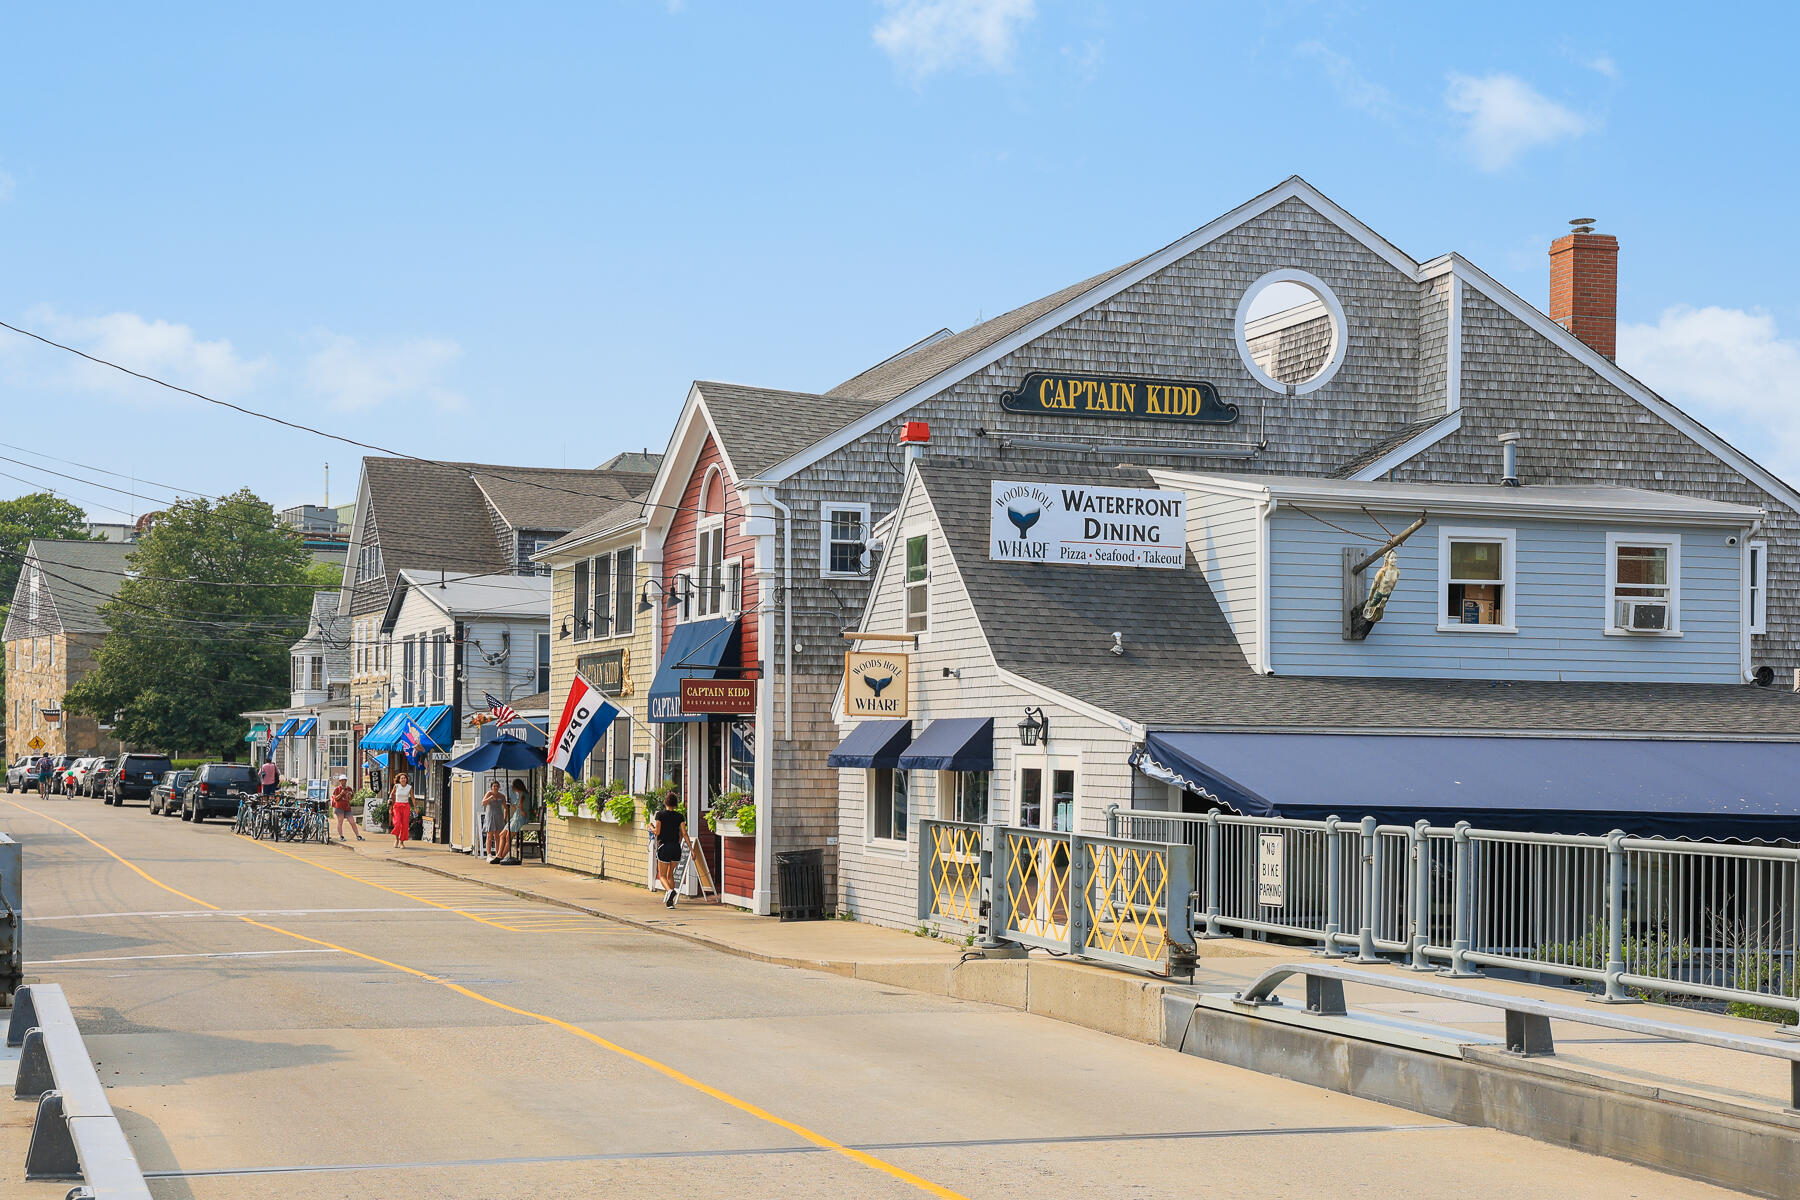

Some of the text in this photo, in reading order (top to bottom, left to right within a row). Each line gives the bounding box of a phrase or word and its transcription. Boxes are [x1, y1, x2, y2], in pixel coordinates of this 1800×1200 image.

[1039, 378, 1202, 416] CAPTAIN KIDD
[995, 486, 1055, 512] WOODS HOLE
[1061, 489, 1182, 517] WATERFRONT
[1084, 517, 1160, 543] DINING
[998, 540, 1050, 559] WHARF
[1060, 546, 1182, 565] Pizza Seafood Takeout
[604, 661, 619, 685] KIDD
[852, 659, 903, 677] WOODS HOLE
[686, 686, 750, 697] CAPTAIN KIDD
[855, 697, 900, 711] WHARF
[371, 771, 380, 792] OPEN
[1266, 842, 1276, 856] NO
[1262, 863, 1279, 878] BIKE
[1259, 883, 1282, 898] PARKING
